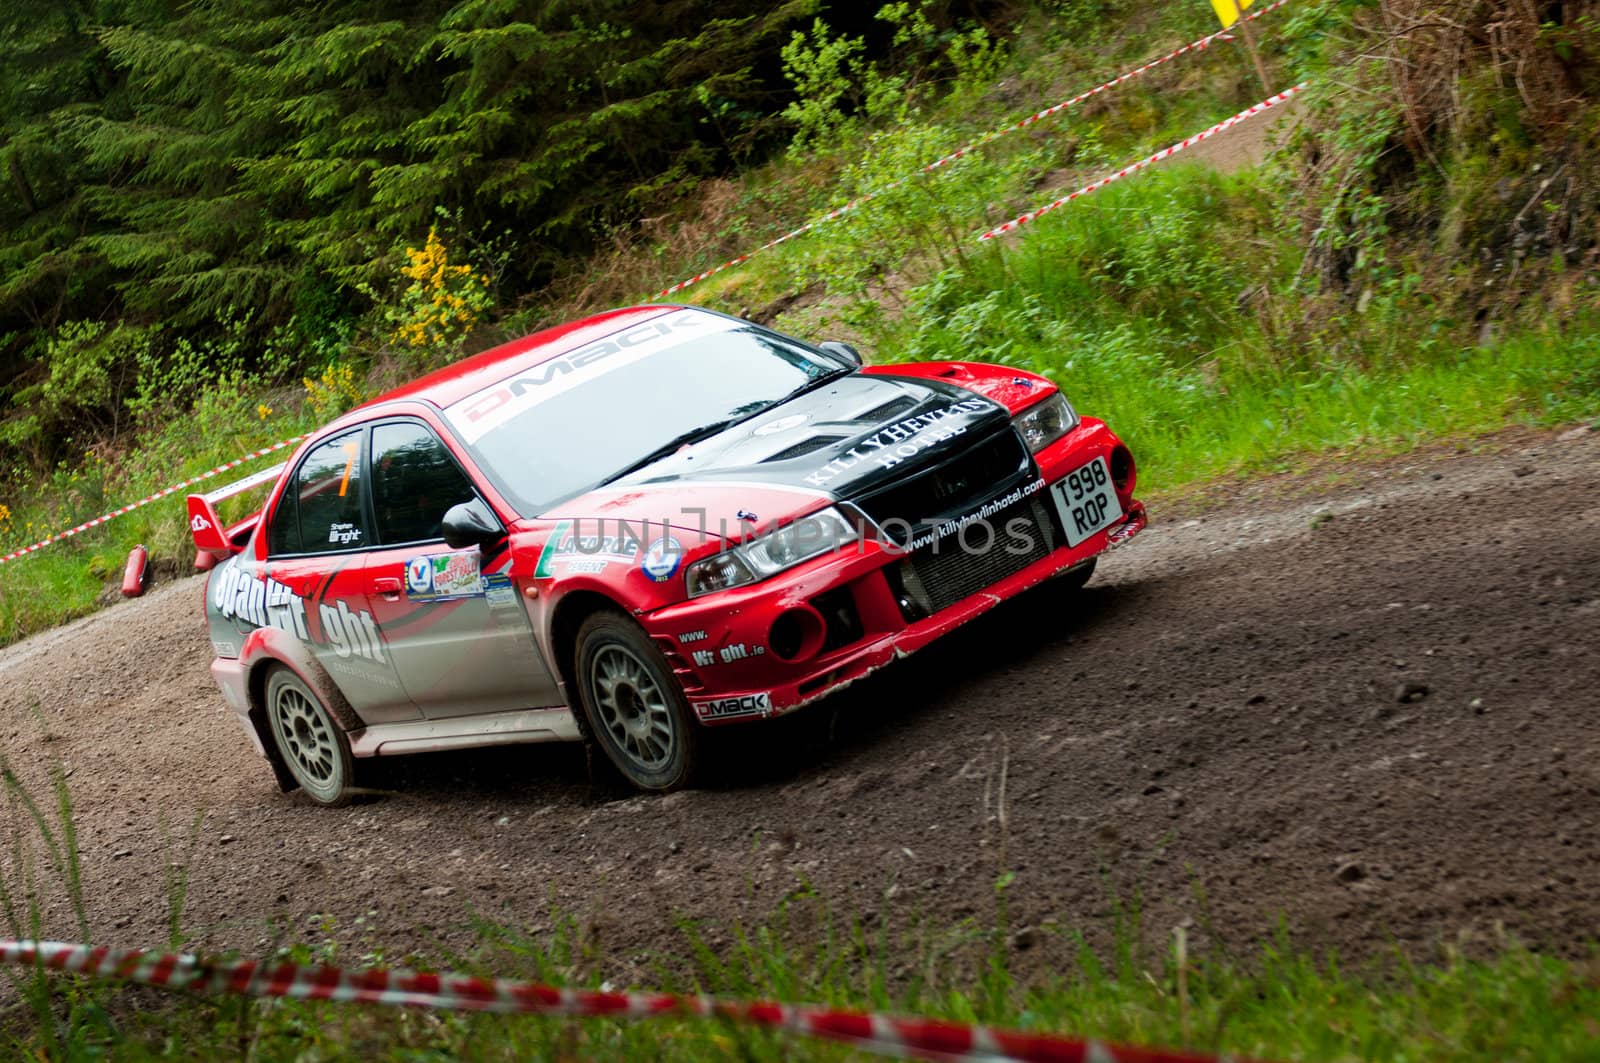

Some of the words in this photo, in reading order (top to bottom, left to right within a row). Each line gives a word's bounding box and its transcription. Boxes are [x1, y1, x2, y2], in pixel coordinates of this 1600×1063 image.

[803, 397, 991, 487] KILLYHEVLIN
[876, 425, 967, 470] HOTEL
[1055, 459, 1107, 507] T998
[1072, 492, 1108, 535] ROP
[679, 630, 708, 643] www.
